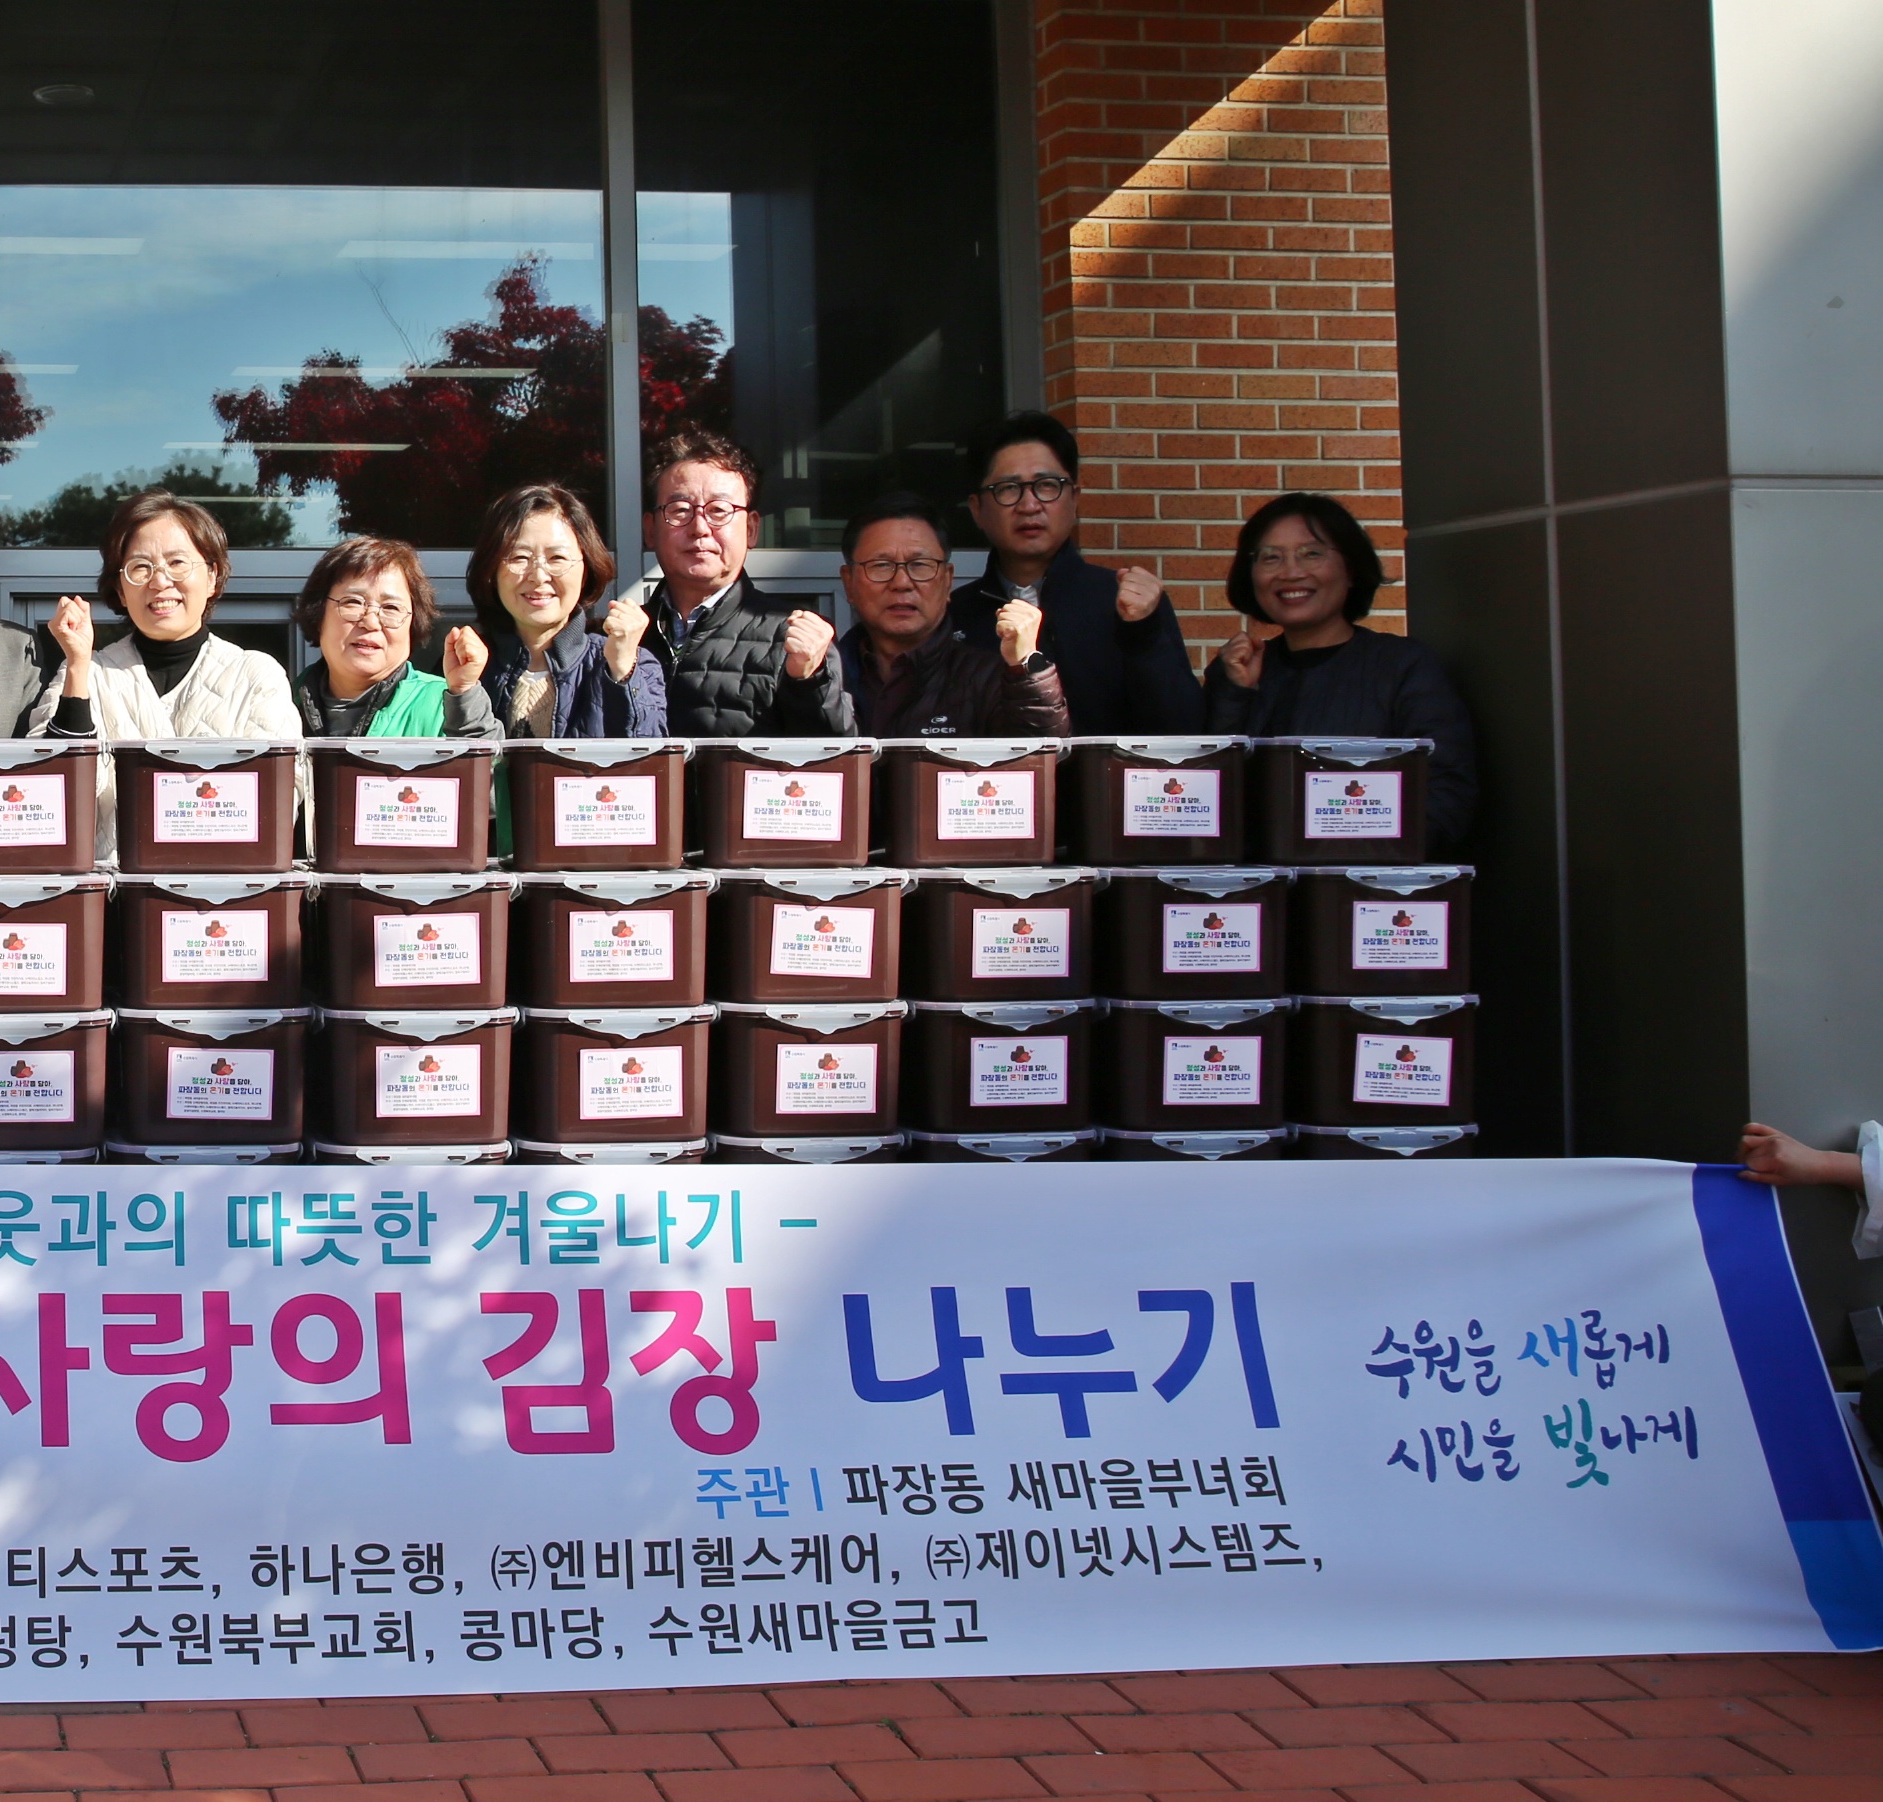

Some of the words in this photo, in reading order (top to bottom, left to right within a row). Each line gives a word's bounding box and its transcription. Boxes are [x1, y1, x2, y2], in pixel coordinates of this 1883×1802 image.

[997, 807, 1024, 815] 전합니다
[1364, 806, 1392, 814] 전합니다
[418, 814, 447, 823] 전합니다
[1223, 939, 1251, 948] 전합니다
[1411, 937, 1438, 945] 전합니다
[633, 947, 662, 956] 전합니다
[24, 961, 55, 970] 전합니다
[1030, 1072, 1058, 1081] 전합니다
[1223, 1072, 1251, 1080] 전합니다
[838, 1081, 866, 1089] 전합니다
[231, 1086, 262, 1095] 전합니다
[226, 1190, 438, 1267] 따뜻한
[472, 1190, 743, 1266] 겨울나기
[1365, 1319, 1502, 1400] 수원을
[1517, 1309, 1671, 1391] 새롭게
[480, 1287, 783, 1456] 김장
[842, 1281, 1281, 1439] 나누기
[1386, 1418, 1521, 1484] 시민을
[1543, 1398, 1699, 1489] 빛나게
[696, 1466, 790, 1520] 주관
[842, 1463, 985, 1516] 파장동
[1007, 1455, 1287, 1512] 새마을부녀회
[249, 1542, 464, 1596] 하나은행,
[116, 1610, 435, 1667] 수원북부교회,
[460, 1606, 624, 1662] 콩마당,
[648, 1599, 989, 1657] 수원새마을금고
